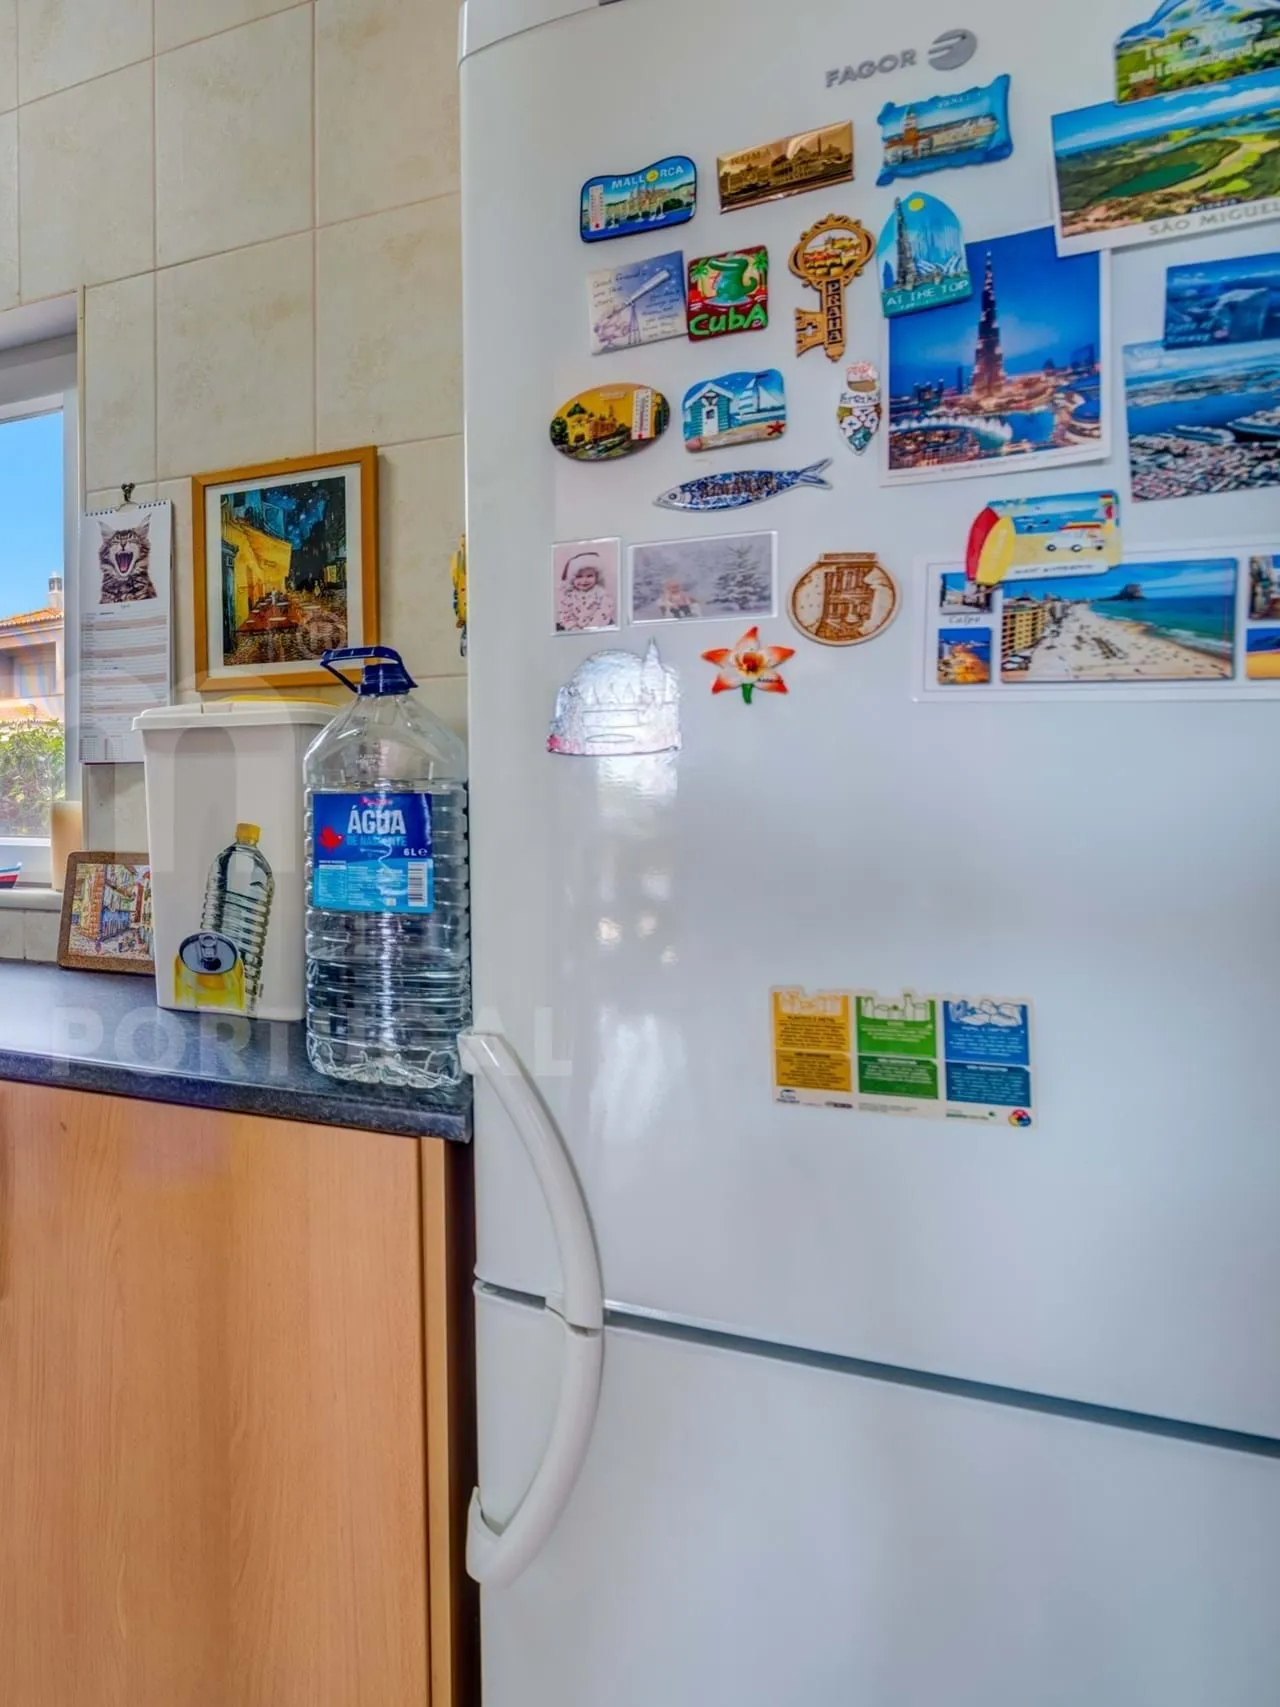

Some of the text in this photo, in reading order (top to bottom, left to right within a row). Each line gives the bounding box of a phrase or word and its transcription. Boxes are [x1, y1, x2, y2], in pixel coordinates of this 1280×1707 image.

[825, 49, 918, 88] FAGOR
[611, 164, 684, 190] MALLORCA
[1149, 218, 1191, 236] SÃO
[911, 287, 937, 302] THE
[942, 279, 969, 294] TOP
[347, 805, 407, 835] ÁGUA
